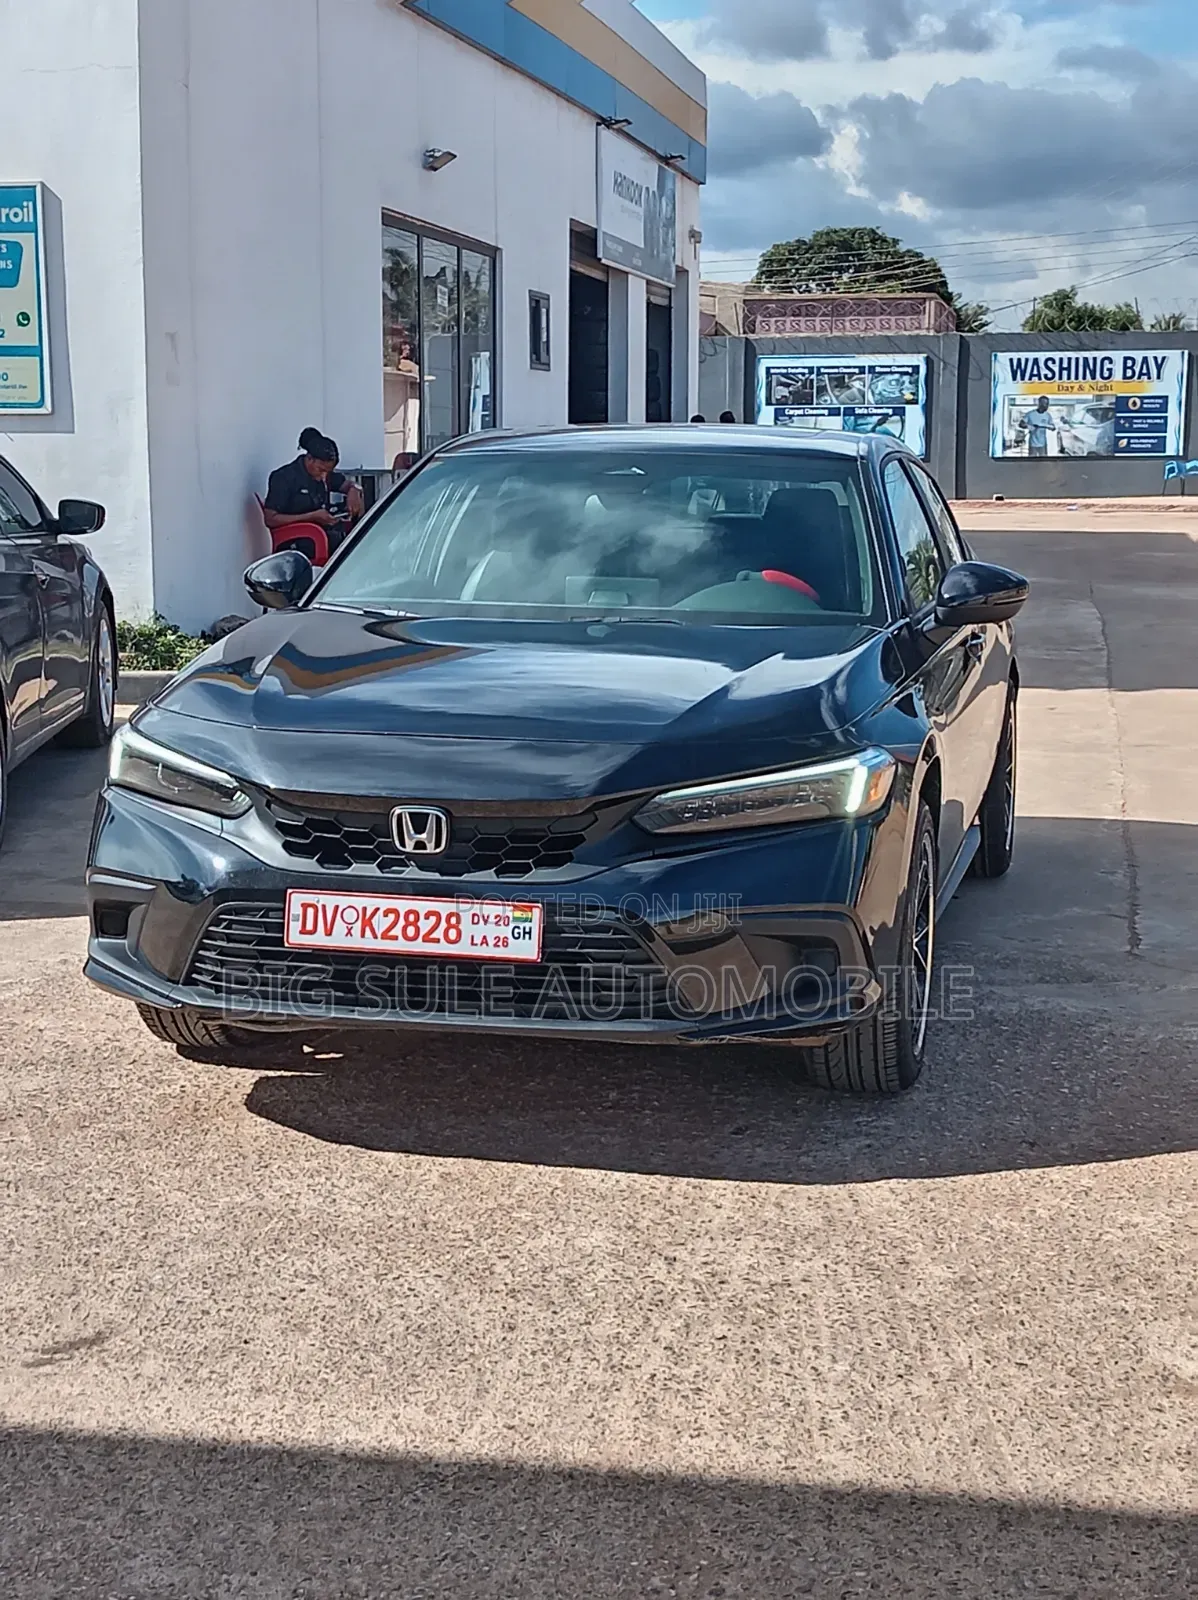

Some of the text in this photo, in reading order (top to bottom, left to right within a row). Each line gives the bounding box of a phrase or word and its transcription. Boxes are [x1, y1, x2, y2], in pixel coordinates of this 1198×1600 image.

[1009, 355, 1168, 382] WASHING BAY
[1057, 382, 1114, 393] Day & Night
[785, 408, 829, 416] Carpet Cleaning
[855, 407, 893, 416] Sofa Cleaning
[299, 902, 463, 945] DV K2828
[471, 912, 511, 928] DV 20
[511, 925, 533, 941] GH
[470, 935, 510, 949] LA 26
